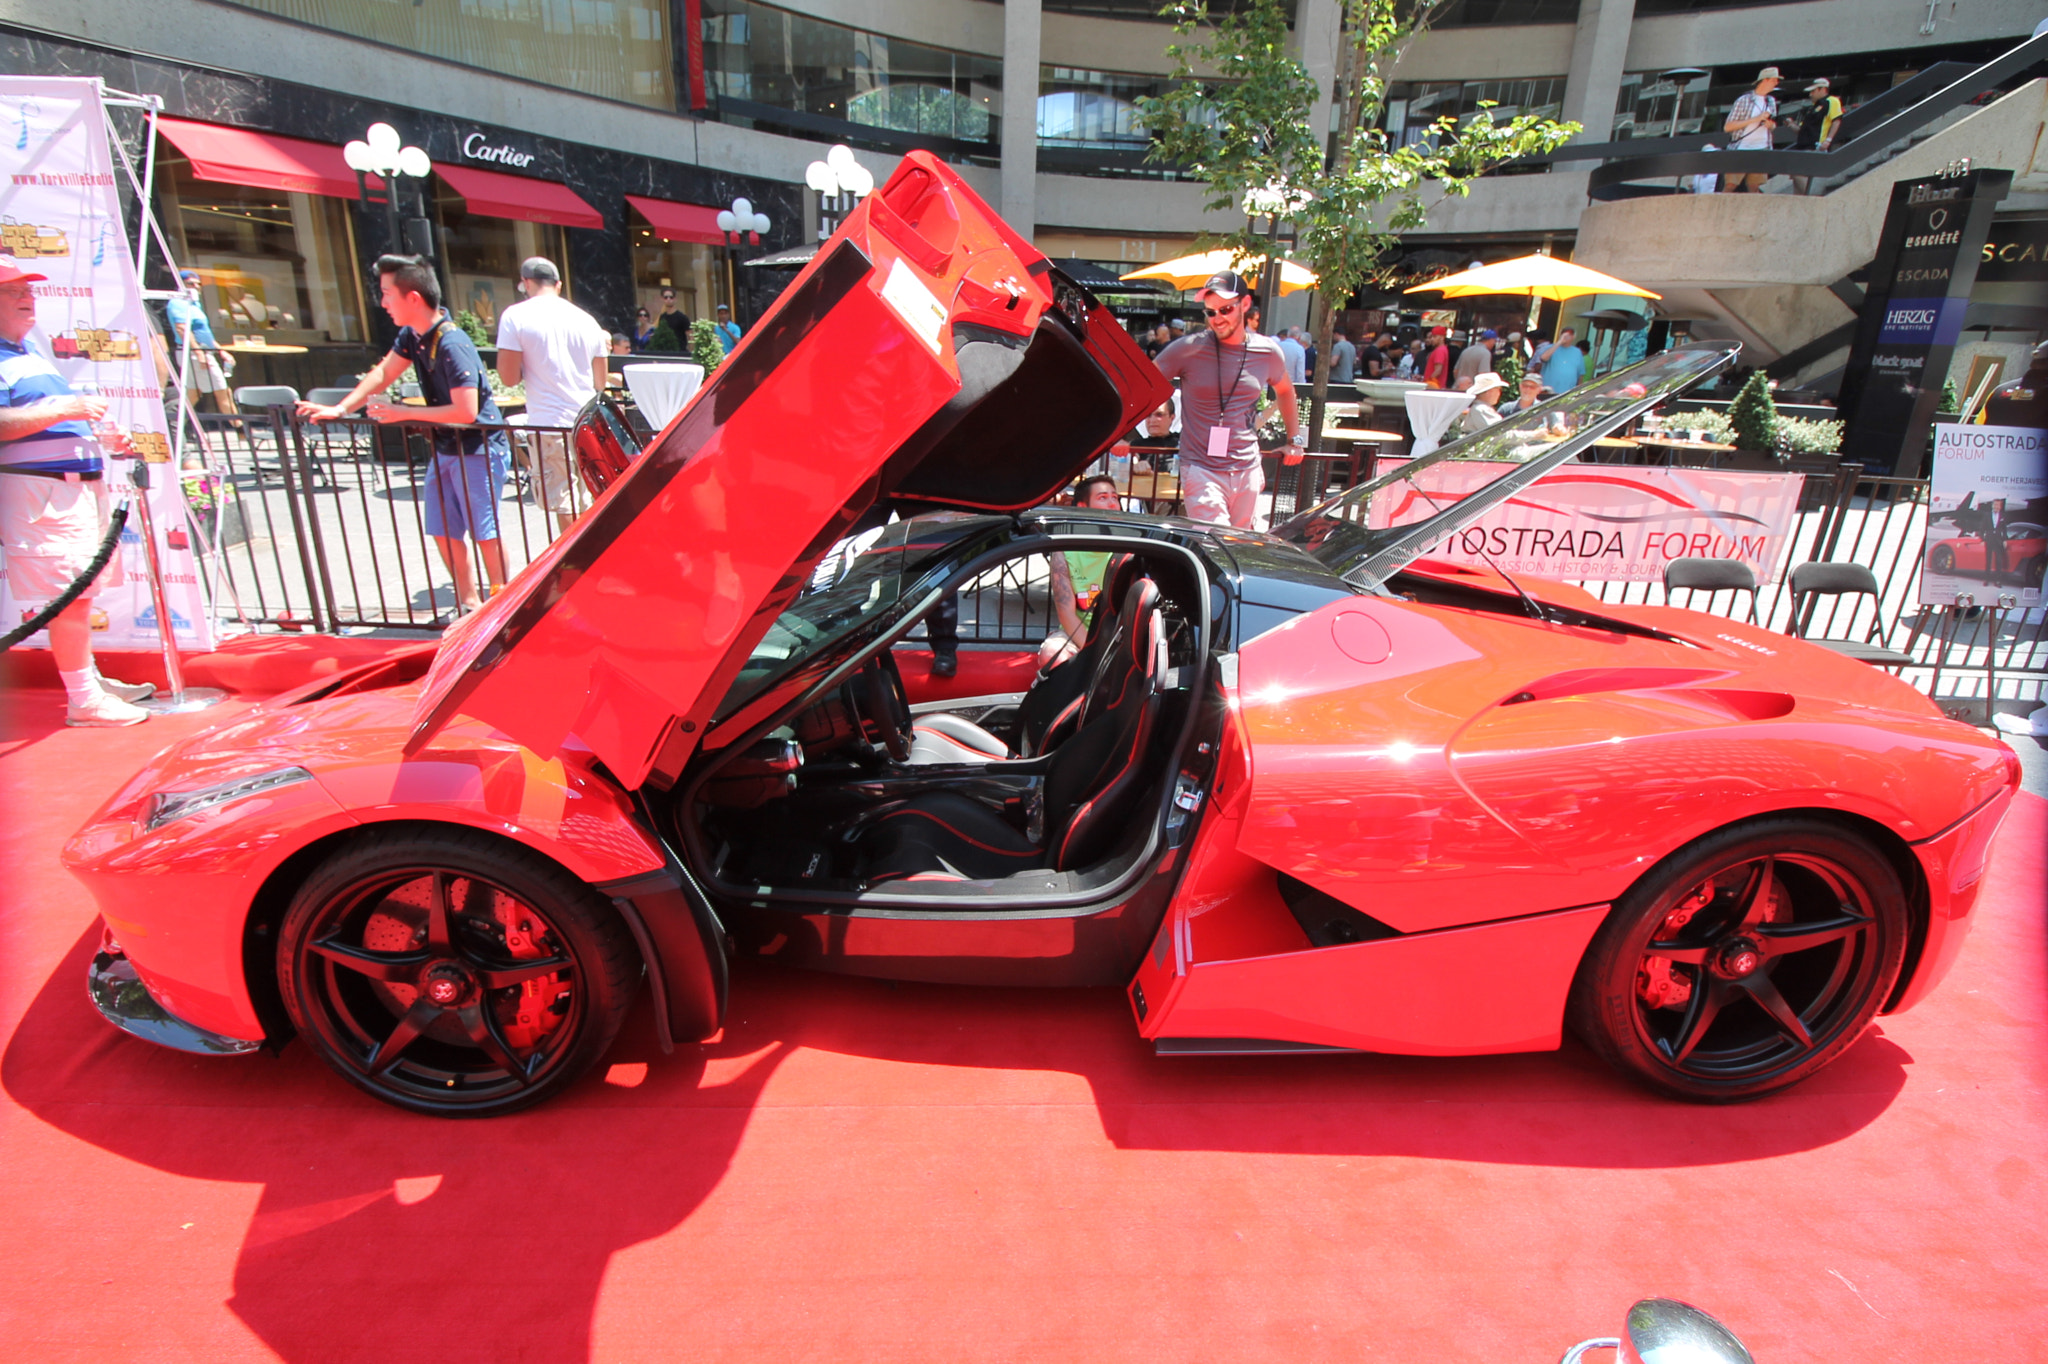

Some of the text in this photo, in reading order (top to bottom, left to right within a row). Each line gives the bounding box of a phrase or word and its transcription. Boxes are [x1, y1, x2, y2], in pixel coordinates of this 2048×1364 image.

[463, 132, 535, 168] Cartier
[1120, 240, 1157, 261] 131
[1897, 268, 1949, 282] ESCADA
[1886, 310, 1936, 324] HERZIG
[1940, 432, 2048, 451] AUTOSTRADA
[1937, 447, 1985, 461] FORUM
[1980, 476, 2009, 484] ROBERT
[1424, 526, 1766, 562] TOSTRADA FORUM
[1552, 562, 1605, 574] HISTORY
[1609, 564, 1619, 574] &
[1621, 564, 1665, 575] JOURN
